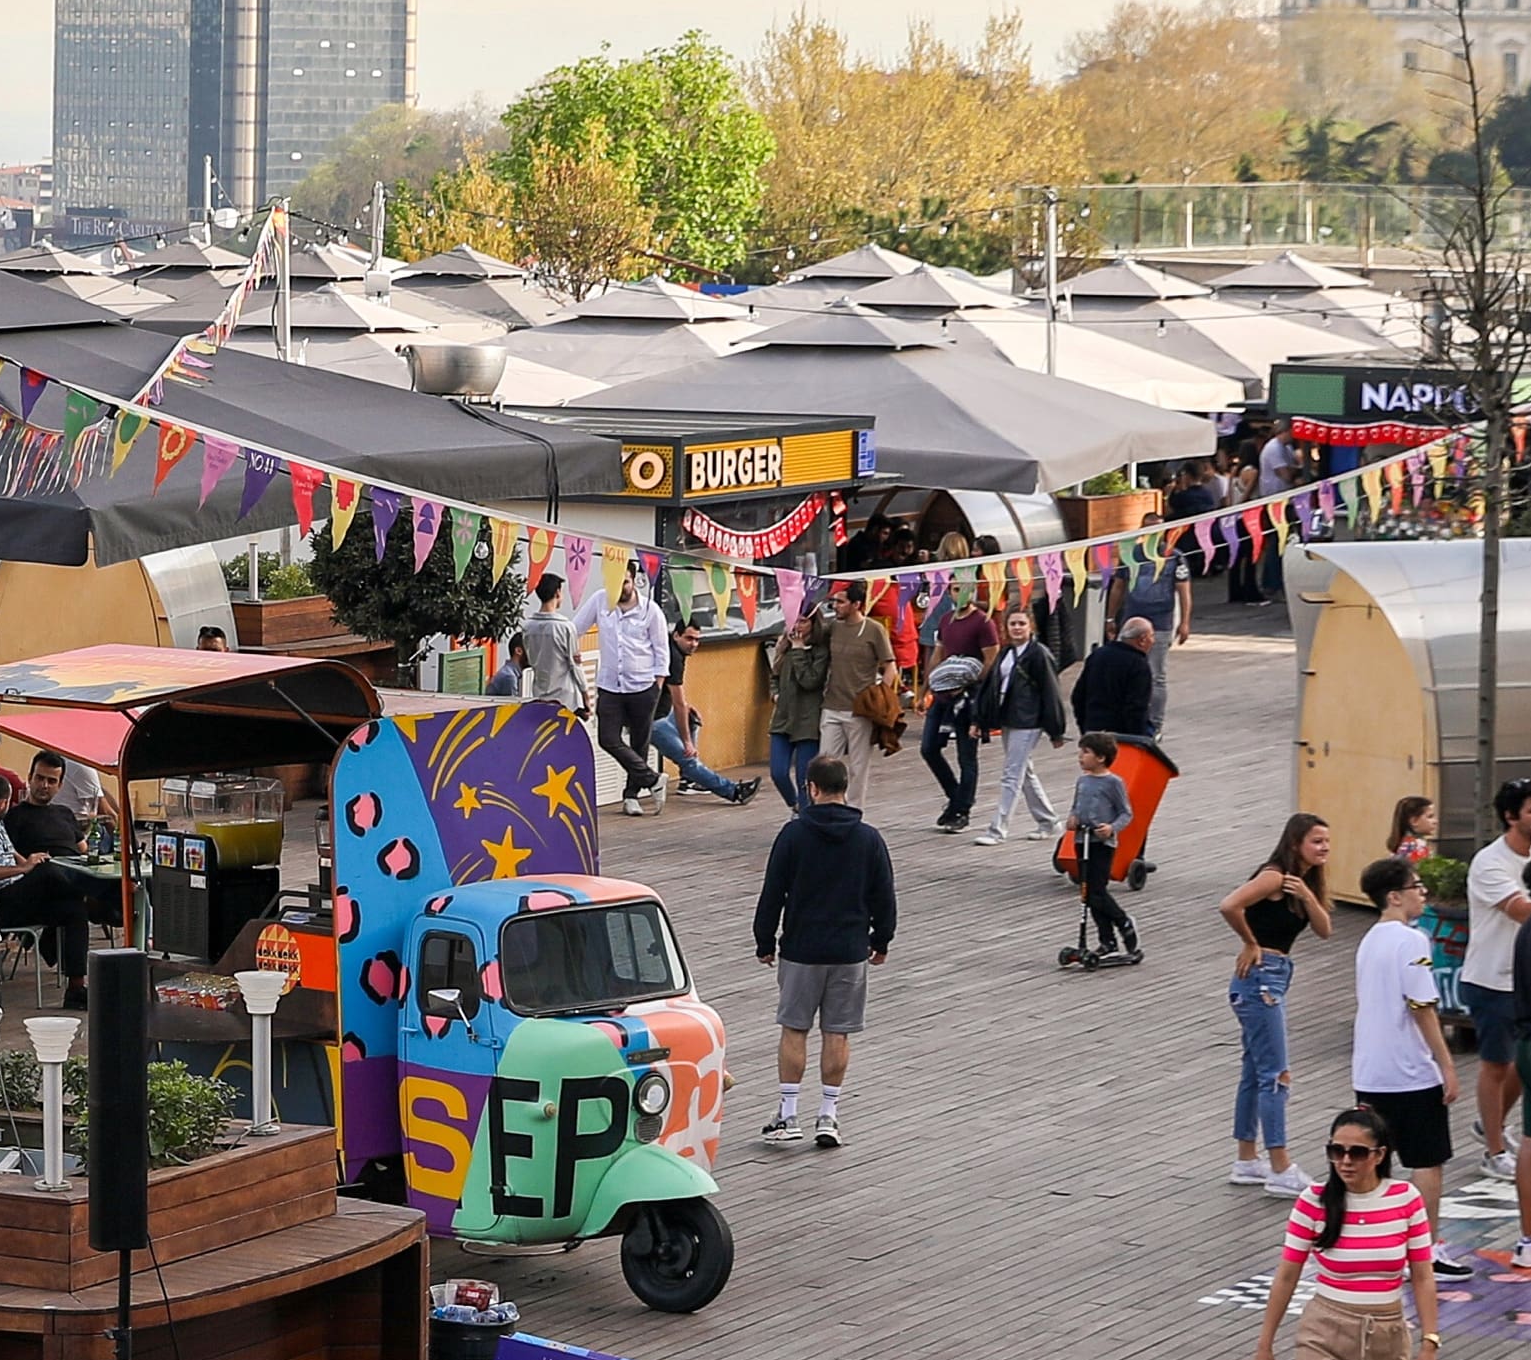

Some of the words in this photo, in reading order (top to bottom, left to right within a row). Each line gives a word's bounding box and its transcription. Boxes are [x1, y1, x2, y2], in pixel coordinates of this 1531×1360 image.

[71, 217, 91, 235] THE
[691, 444, 781, 489] BURGER
[399, 1076, 630, 1219] SEP
